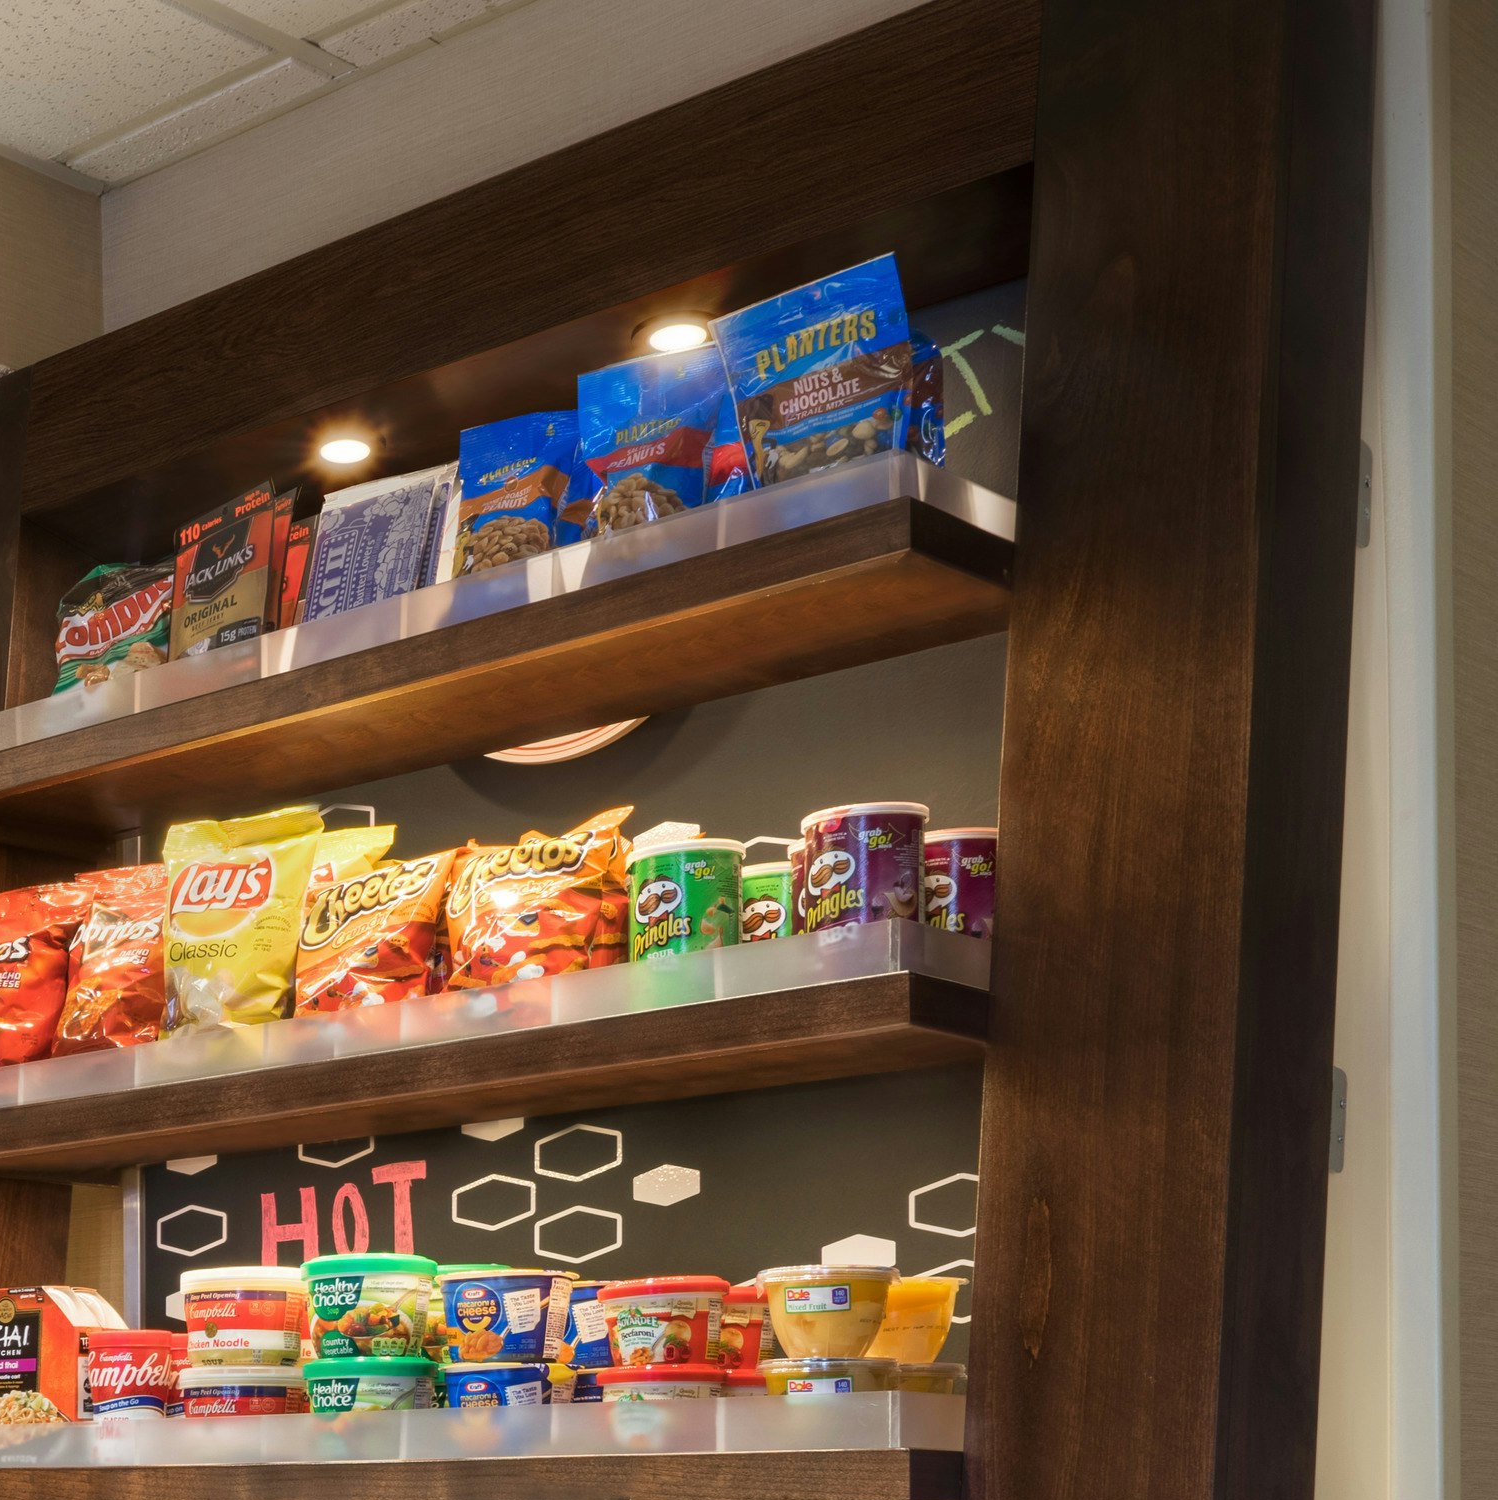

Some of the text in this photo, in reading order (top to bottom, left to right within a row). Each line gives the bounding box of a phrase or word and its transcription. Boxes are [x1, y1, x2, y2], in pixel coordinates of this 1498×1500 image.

[756, 310, 877, 380] PLANTERS
[793, 374, 829, 397] NUTS
[779, 377, 860, 416] CHOCOLATE
[795, 404, 823, 421] TRAIL
[615, 417, 682, 446] PLANTERS
[607, 442, 665, 471] PEANUTS
[235, 491, 270, 517] Protein
[482, 496, 529, 512] PEANUTS
[180, 516, 223, 546] 110 Calories
[183, 568, 214, 594] JACK
[183, 595, 238, 629] ORIGINAL
[220, 627, 237, 643] 15g
[450, 832, 594, 917] Cheetos
[685, 859, 716, 880] grab go!
[173, 859, 273, 915] Lay's
[302, 857, 436, 946] Cheetos
[806, 886, 864, 931] Pringles
[70, 919, 162, 952] Doritos
[633, 916, 692, 957] Pringles
[169, 939, 238, 963] Classic
[261, 1160, 427, 1266] HOT
[314, 1277, 359, 1294] Healthy
[465, 1290, 482, 1298] Kraft
[786, 1289, 811, 1301] Dole
[214, 1291, 239, 1301] Opening
[312, 1291, 355, 1307] Choice
[457, 1300, 489, 1309] macaroni
[521, 1293, 536, 1302] Taste
[788, 1302, 806, 1312] Mixed
[212, 1338, 250, 1348] Noodle
[322, 1338, 349, 1350] Country
[322, 1346, 353, 1356] Vegetable
[4, 1361, 18, 1370] thai
[313, 1380, 354, 1396] Healthy
[99, 1403, 110, 1412] Soup
[312, 1393, 353, 1408] Choice
